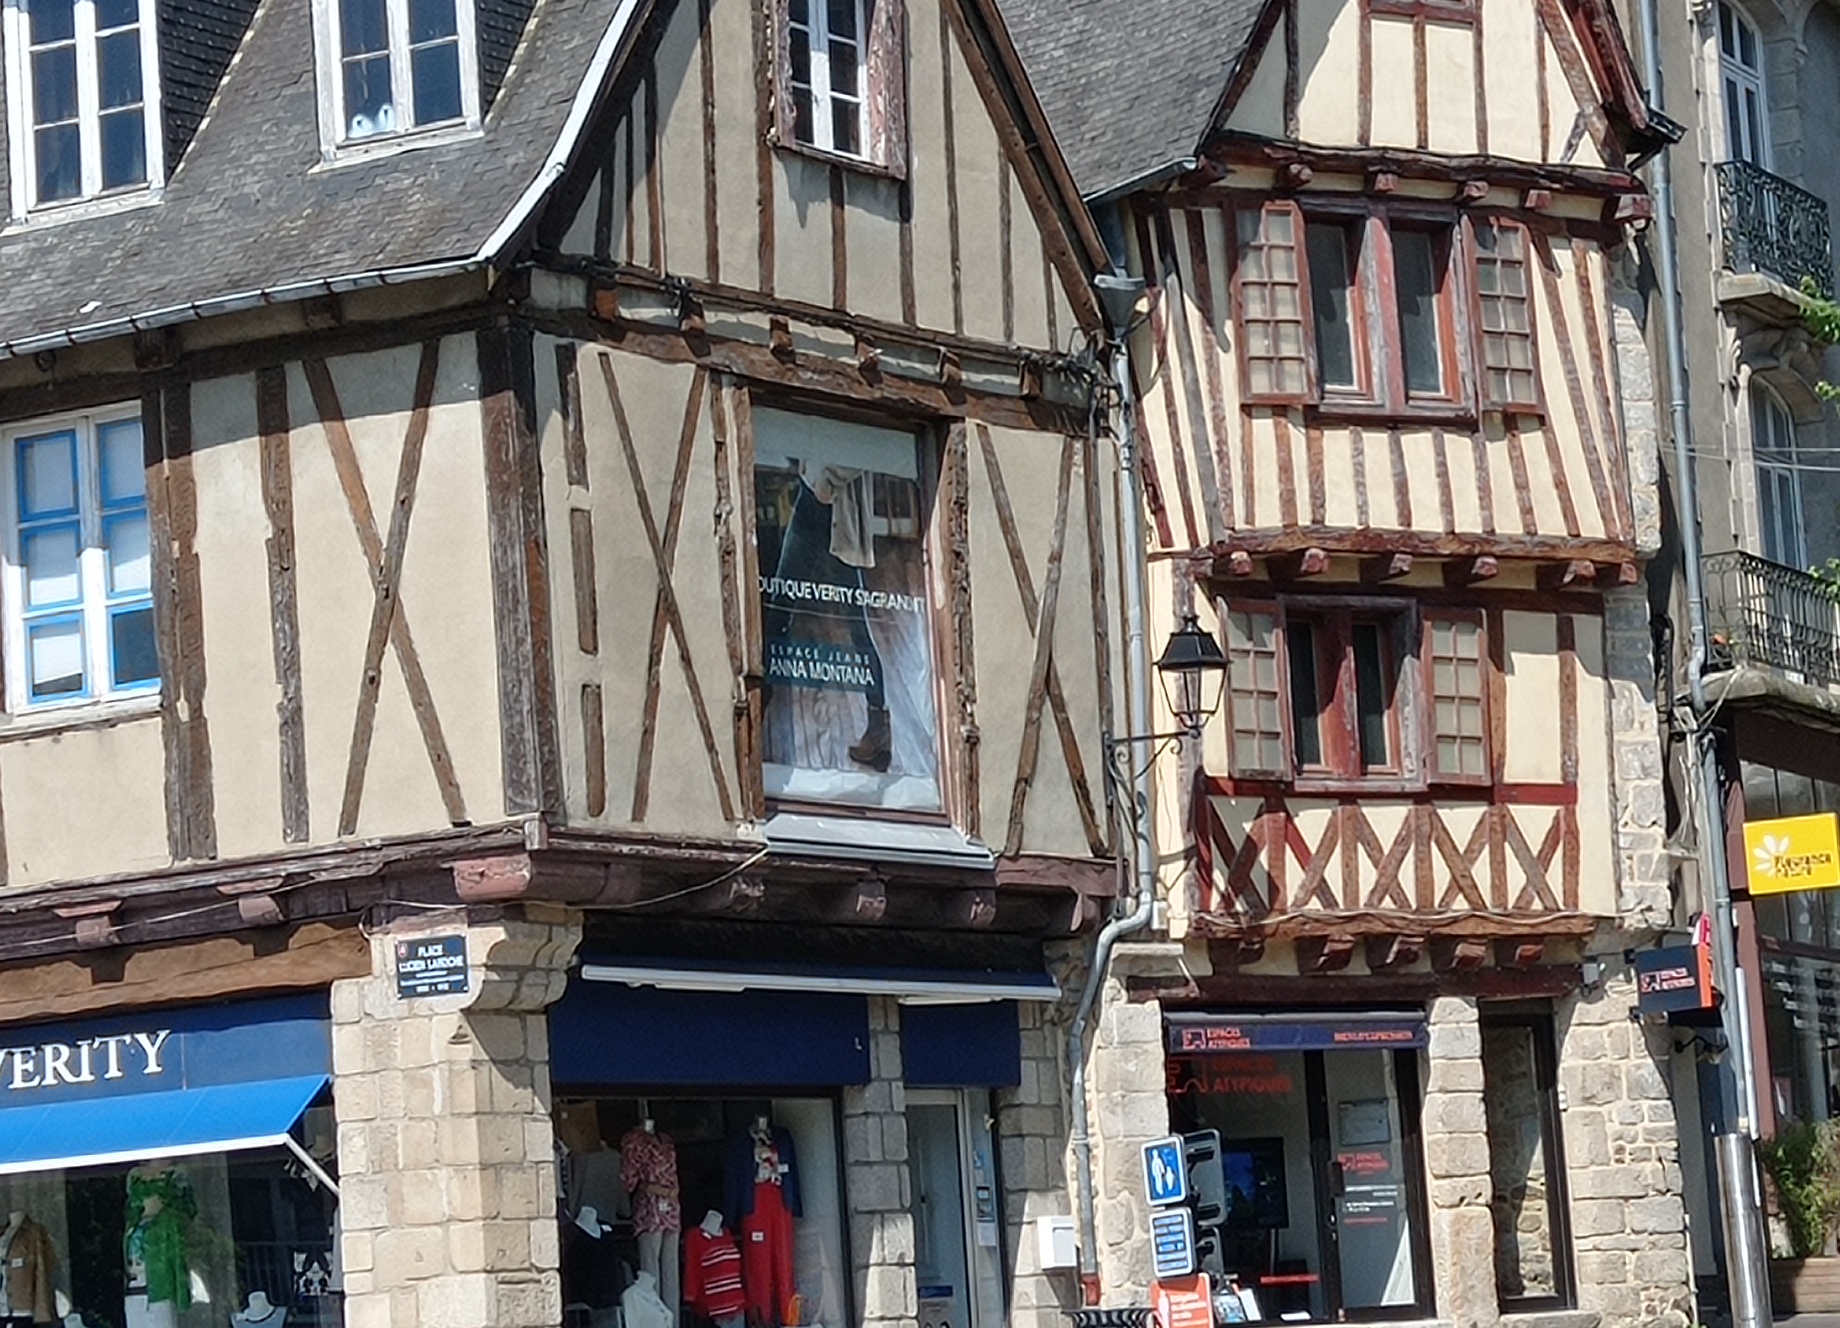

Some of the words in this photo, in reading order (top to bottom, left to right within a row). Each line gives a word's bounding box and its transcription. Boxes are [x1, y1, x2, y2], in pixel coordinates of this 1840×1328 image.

[811, 583, 854, 604] VERITY
[769, 658, 807, 678] ANNA
[808, 661, 875, 686] MONTANA
[0, 1029, 171, 1090] ERITY
